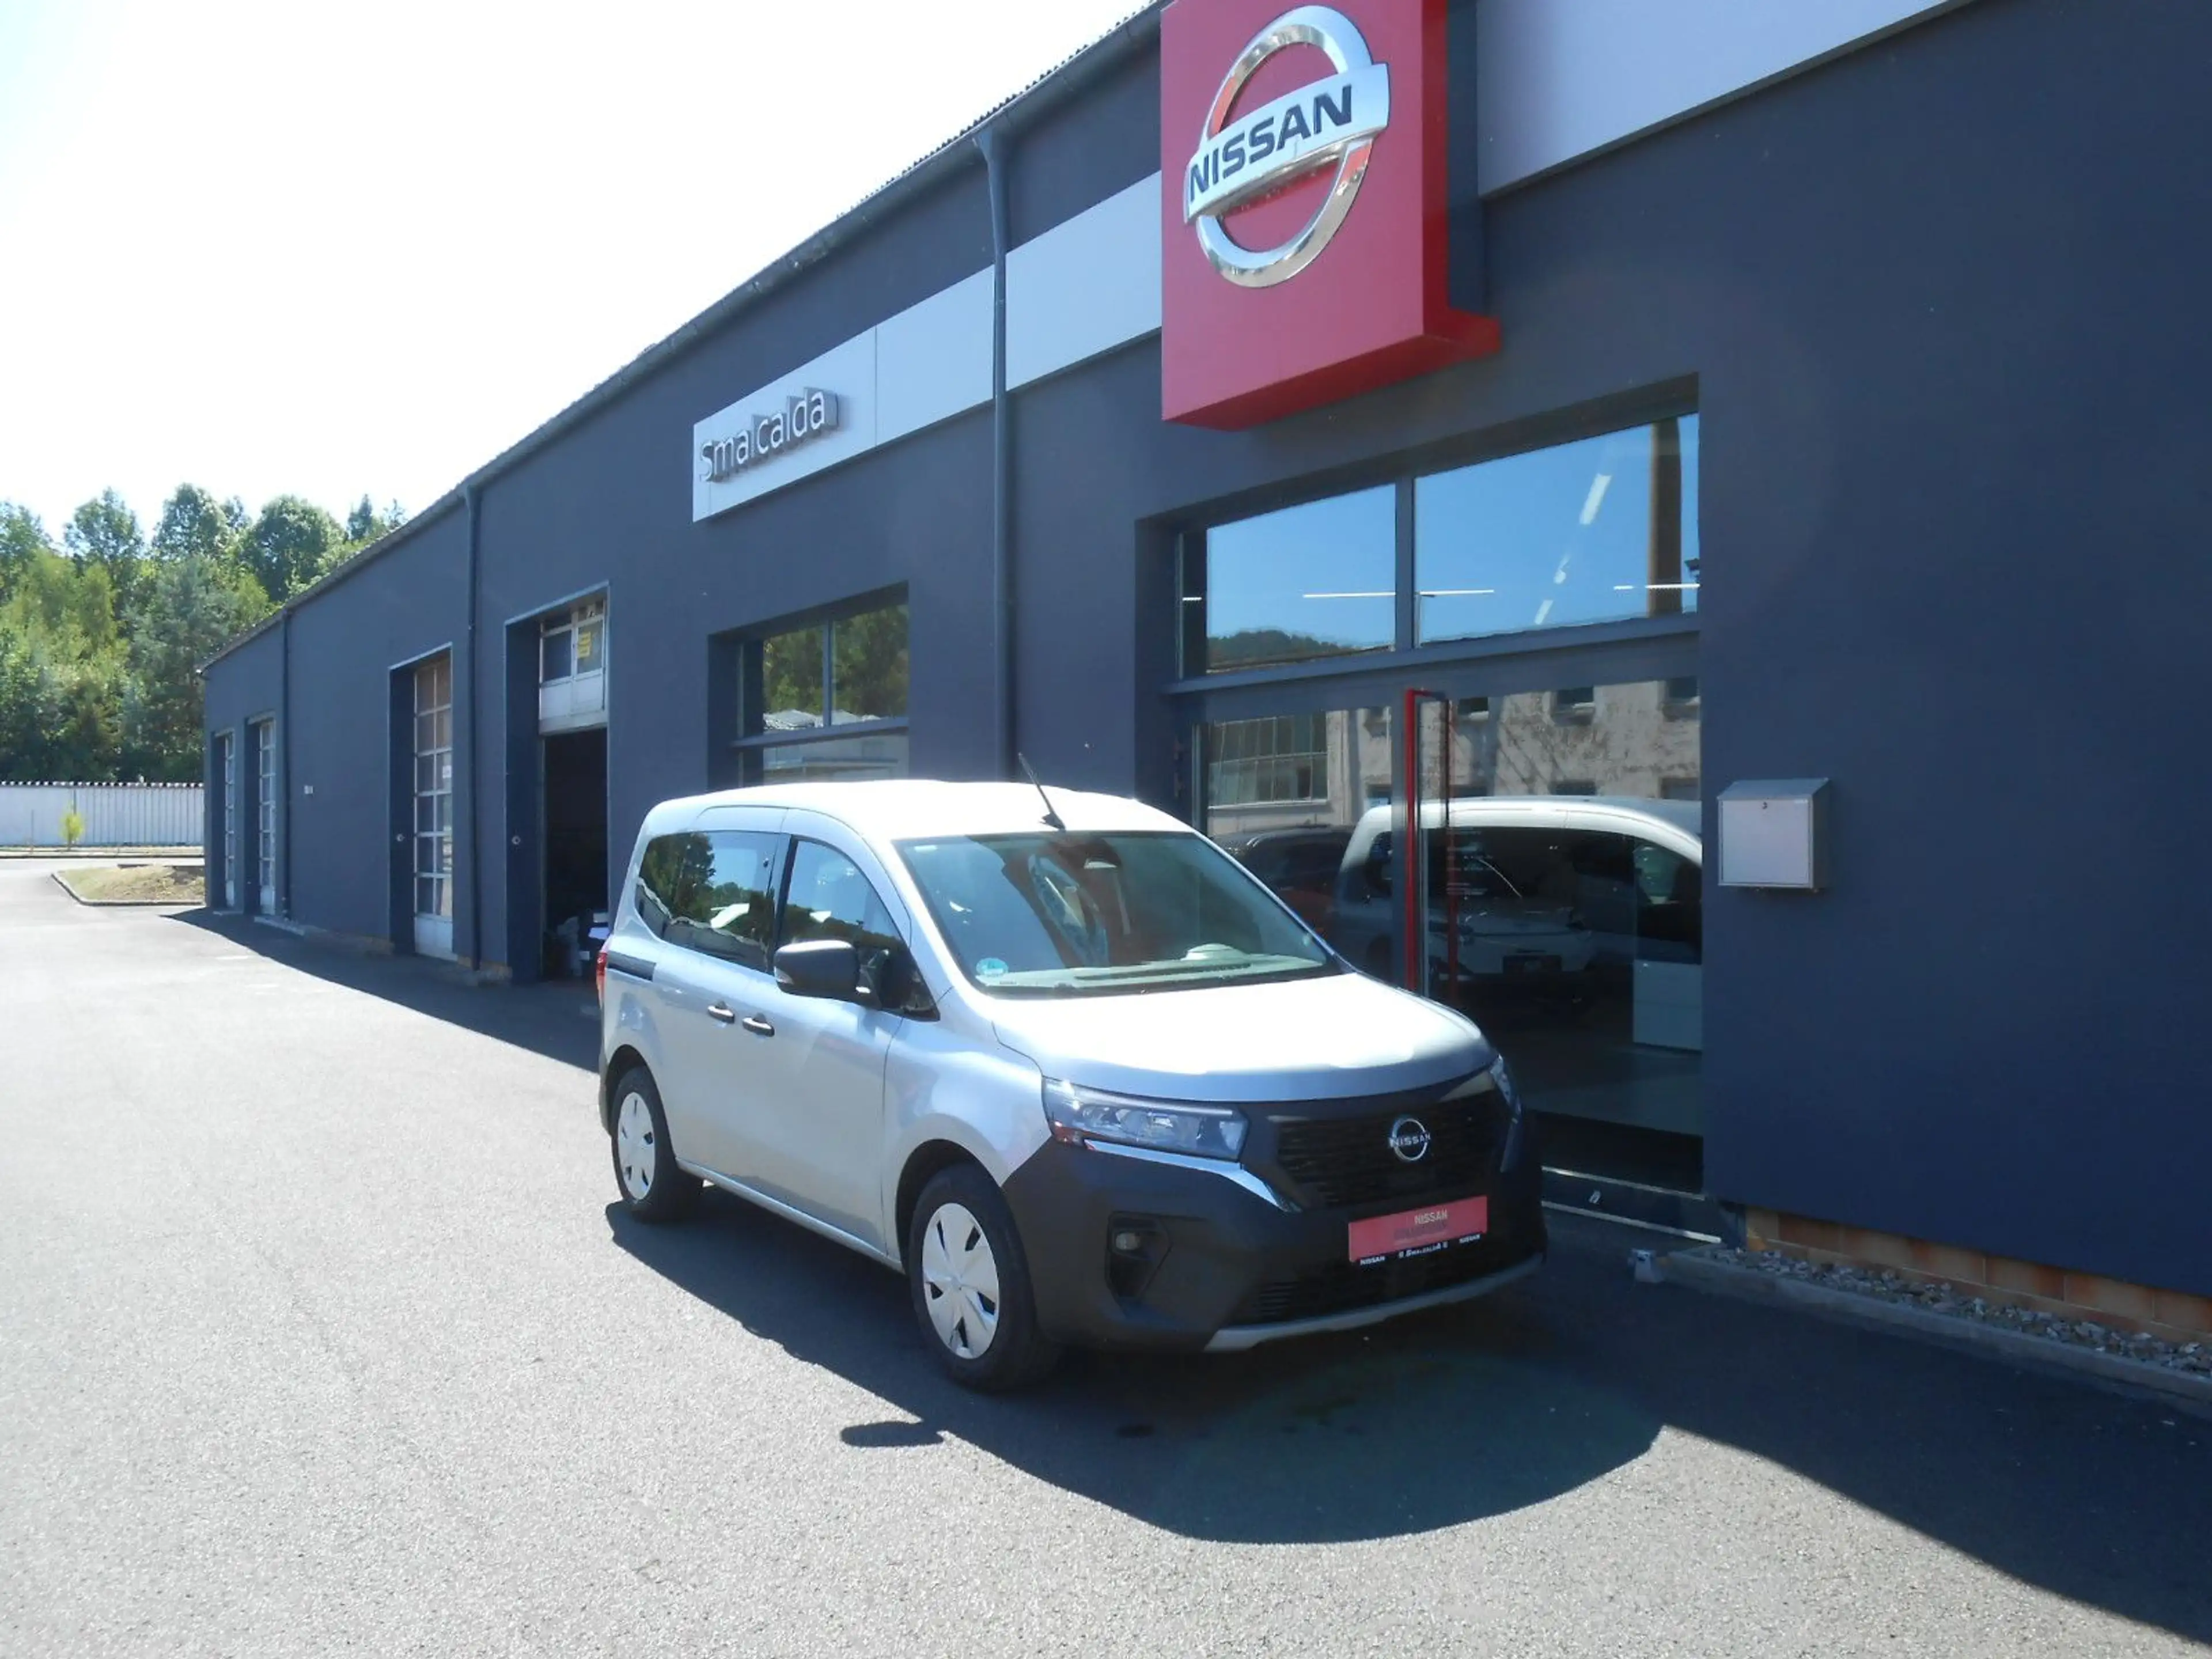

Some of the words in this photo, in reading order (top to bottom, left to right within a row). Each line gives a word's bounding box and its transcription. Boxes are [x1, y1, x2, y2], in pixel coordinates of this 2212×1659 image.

[1189, 84, 1352, 203] NISSAN
[699, 387, 828, 482] Smalcalda
[1389, 1132, 1430, 1147] NISSAN
[1414, 1209, 1448, 1225] NISSAN
